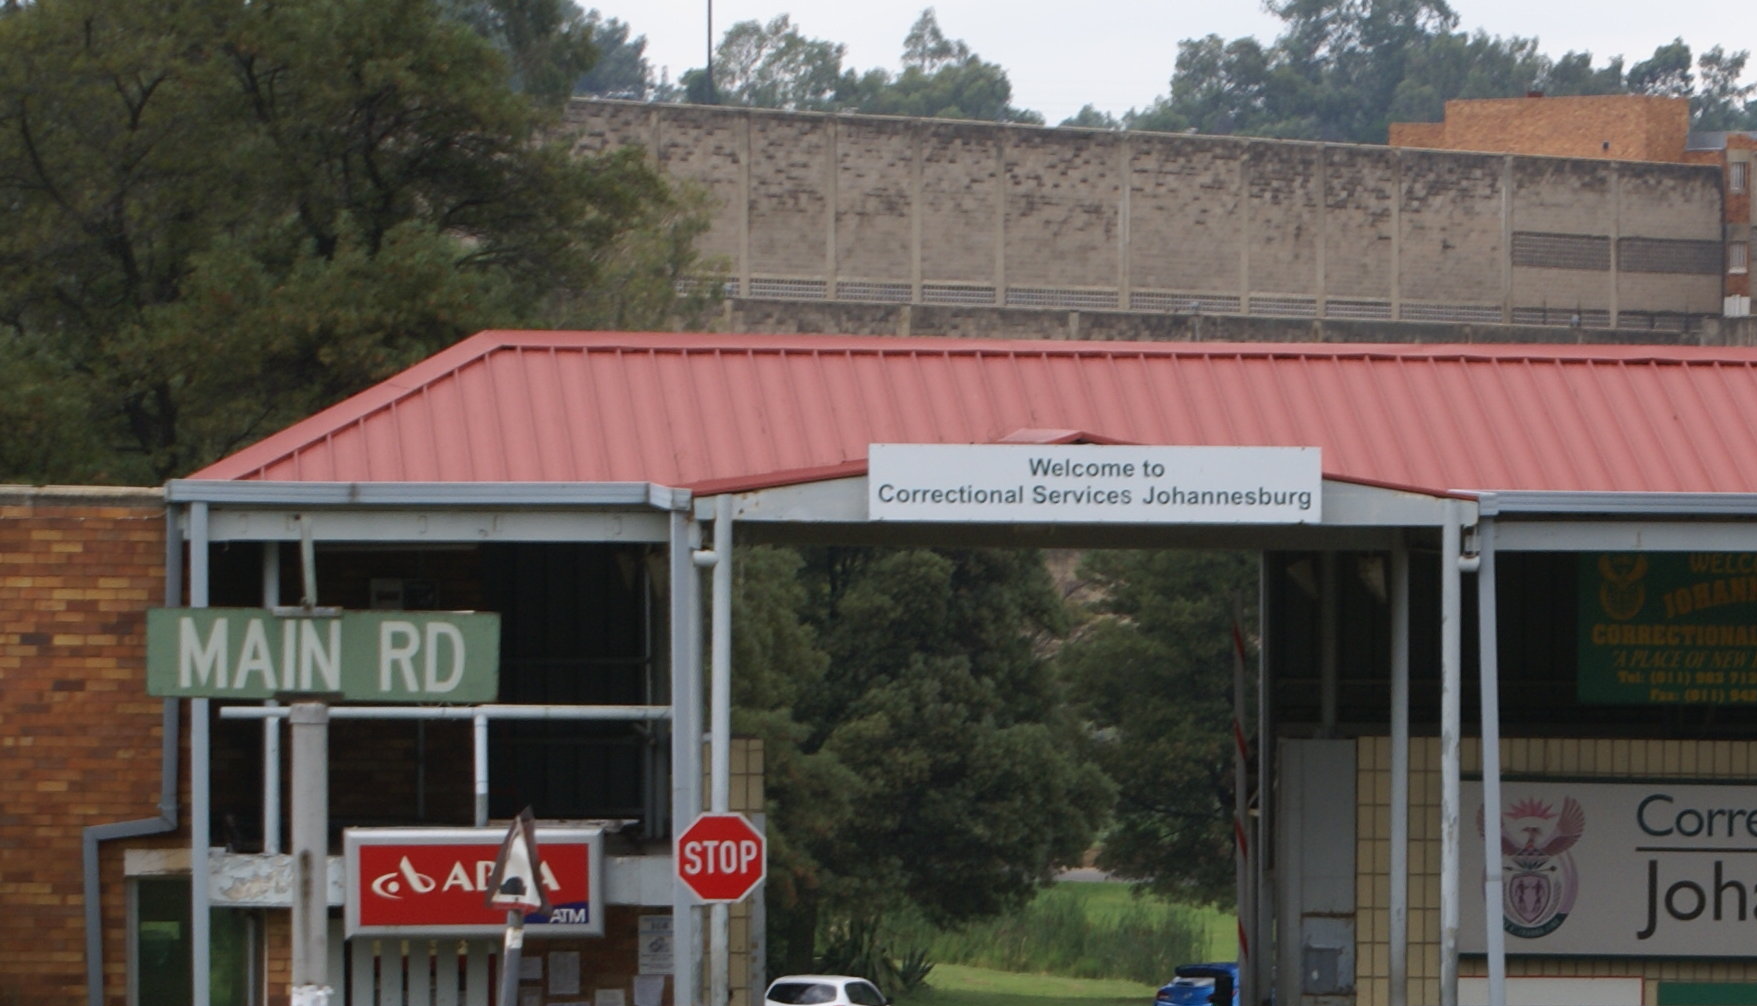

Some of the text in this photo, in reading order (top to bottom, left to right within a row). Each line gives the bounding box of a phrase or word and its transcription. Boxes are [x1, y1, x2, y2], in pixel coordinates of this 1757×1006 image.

[1029, 457, 1166, 478] Welcome to
[877, 483, 1313, 511] Correctional Services Johannesburg
[179, 617, 466, 693] MAIN RD
[1629, 650, 1682, 668] PLACE
[1684, 650, 1707, 668] OF
[1710, 650, 1748, 668] NEW
[684, 840, 758, 875] STOP
[442, 860, 561, 892] ABA
[550, 908, 586, 923] ATM
